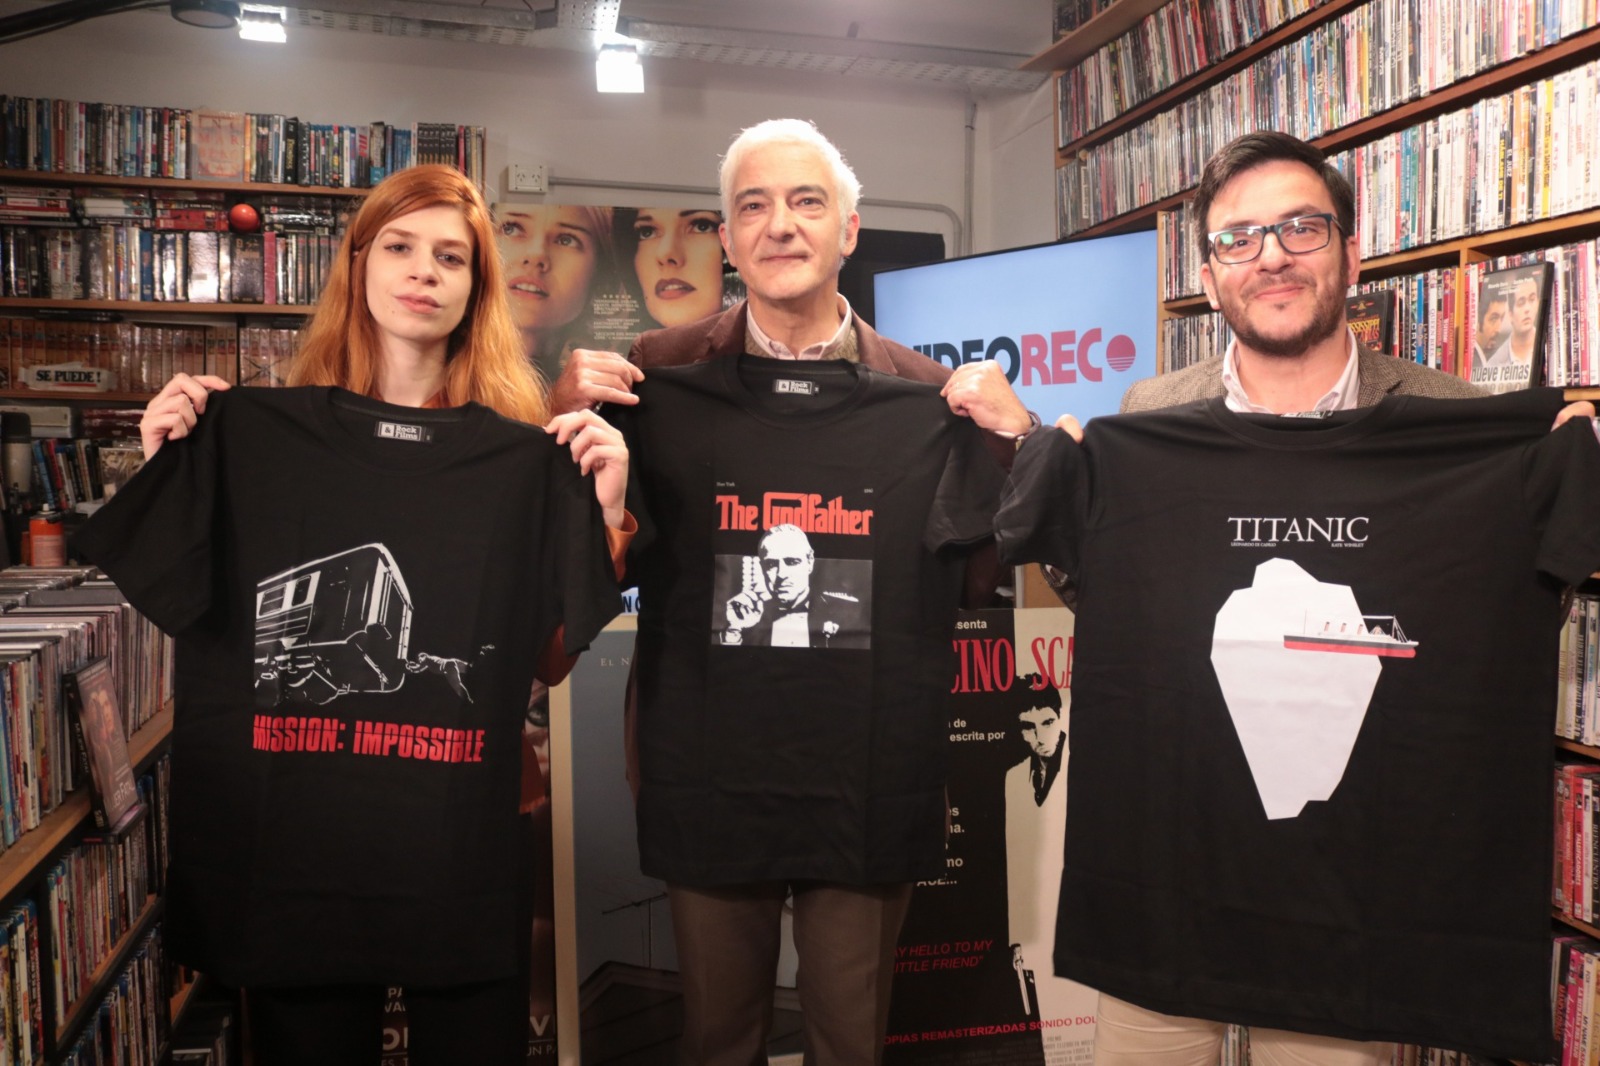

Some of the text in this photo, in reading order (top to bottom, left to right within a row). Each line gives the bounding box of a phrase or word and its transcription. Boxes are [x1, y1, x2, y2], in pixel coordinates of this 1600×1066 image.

[36, 370, 52, 382] SE
[54, 370, 94, 382] PUEDE
[1472, 364, 1530, 382] nueve reinas
[395, 432, 418, 440] Films
[396, 424, 417, 434] Rock
[716, 492, 874, 536] The Godfather
[1227, 516, 1370, 542] TITANIC
[954, 619, 988, 630] senta
[954, 718, 966, 728] de
[252, 714, 485, 763] MISSION: IMPOSSIBLE
[950, 730, 1006, 744] escrita por
[910, 942, 950, 956] HELLO
[954, 940, 972, 953] TO
[973, 939, 993, 952] MY
[1554, 984, 1566, 1042] MANDARINAS
[922, 1022, 1026, 1042] REMASTERIZADAS
[1029, 1018, 1072, 1031] SONIDO
